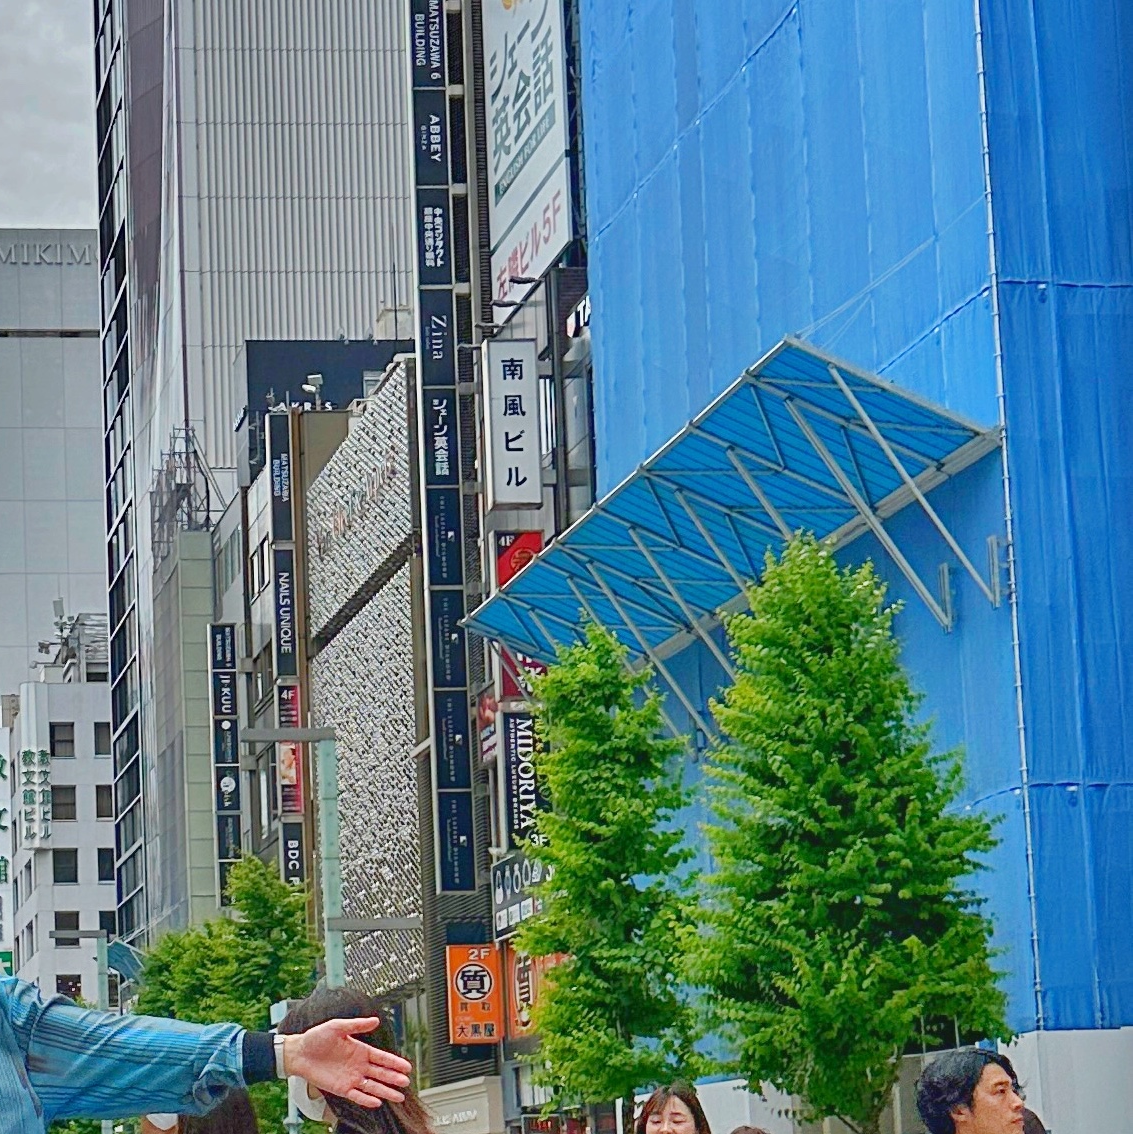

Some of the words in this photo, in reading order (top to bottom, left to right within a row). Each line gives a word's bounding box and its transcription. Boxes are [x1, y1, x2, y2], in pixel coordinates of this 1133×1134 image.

[414, 14, 426, 67] BUILDING
[429, 0, 442, 69] MATSUZAWA
[430, 72, 439, 80] 6
[492, 25, 554, 175] 英会話
[429, 114, 442, 162] ABBEY
[431, 315, 447, 360] Zina
[501, 358, 527, 487] 南風ビル
[498, 536, 515, 547] 4F
[278, 572, 291, 605] NAILS
[279, 608, 292, 654] UNIQUE
[281, 689, 296, 700] 4F
[516, 718, 537, 829] MIDORIYA
[287, 839, 300, 870] BDC
[530, 833, 548, 847] 3F
[468, 948, 490, 960] 2F
[460, 968, 488, 996] 質
[457, 1023, 495, 1038] 大黒屋
